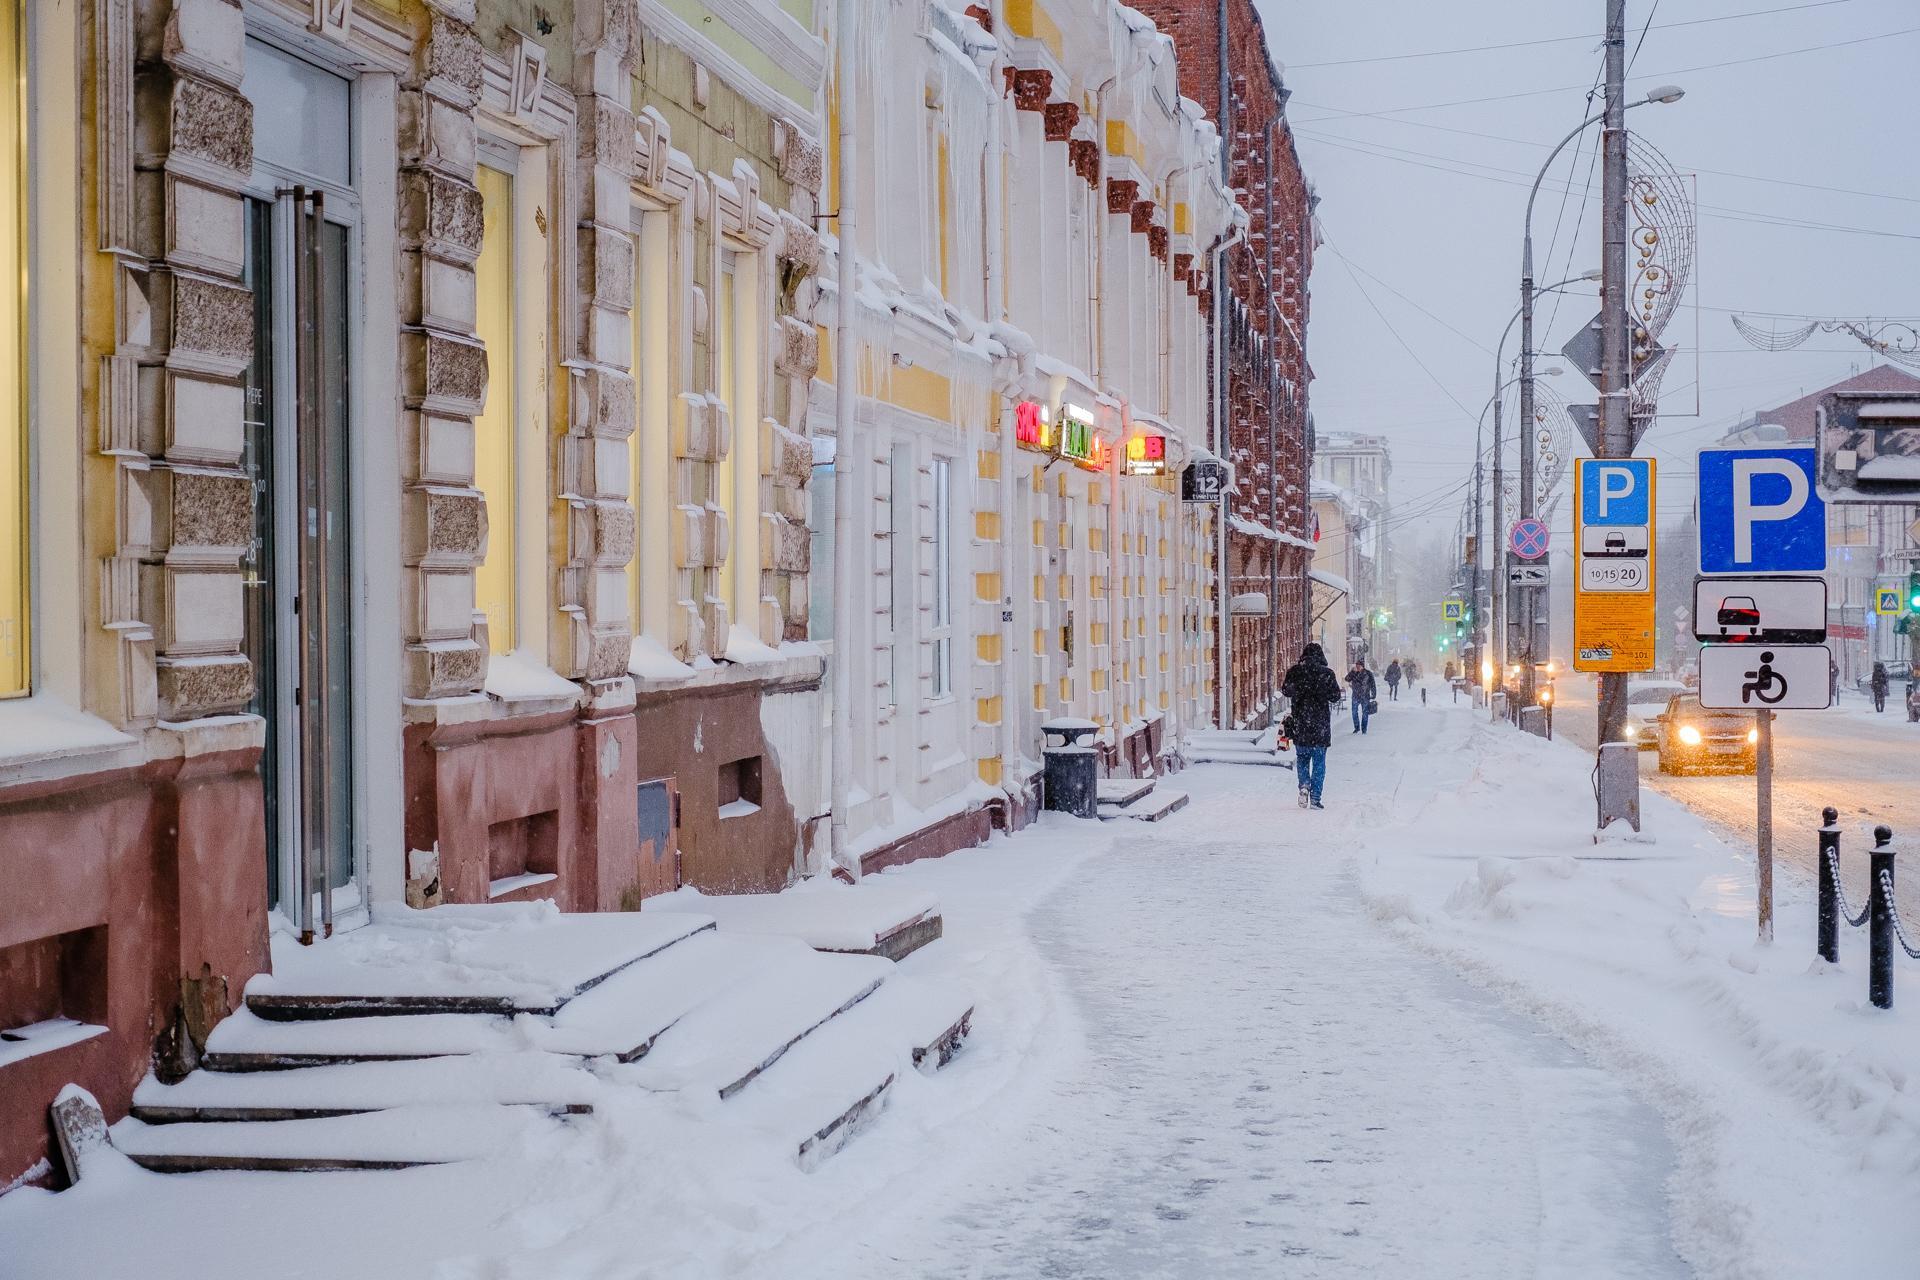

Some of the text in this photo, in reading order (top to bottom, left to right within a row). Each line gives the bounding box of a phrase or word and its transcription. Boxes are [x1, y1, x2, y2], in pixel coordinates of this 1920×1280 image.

[1196, 476, 1219, 493] 12
[1599, 467, 1635, 518] P
[1732, 458, 1810, 564] P
[1591, 569, 1636, 580] 10 15 20
